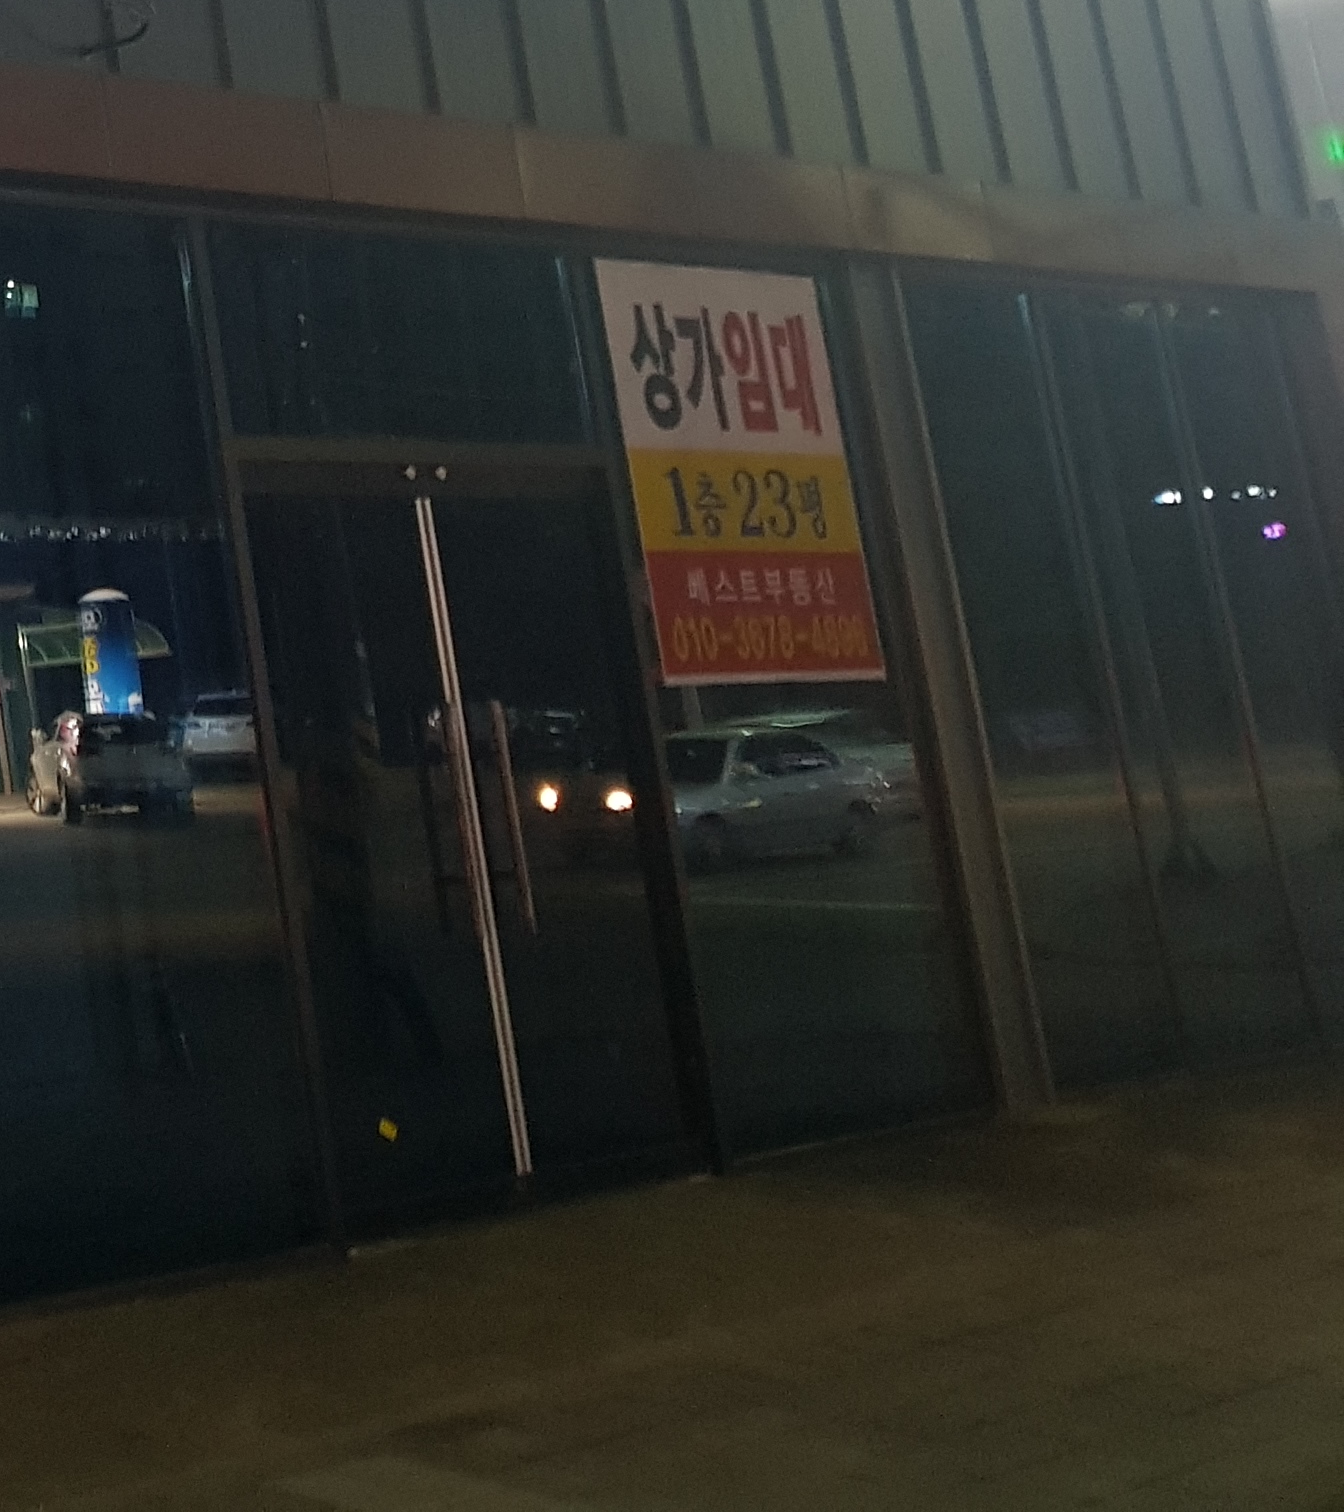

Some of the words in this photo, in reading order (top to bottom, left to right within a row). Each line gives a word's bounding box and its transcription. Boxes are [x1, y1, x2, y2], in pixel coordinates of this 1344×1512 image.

[628, 301, 823, 436] 상가임대
[664, 466, 727, 538] 1층
[686, 567, 837, 606] 베스트부동산
